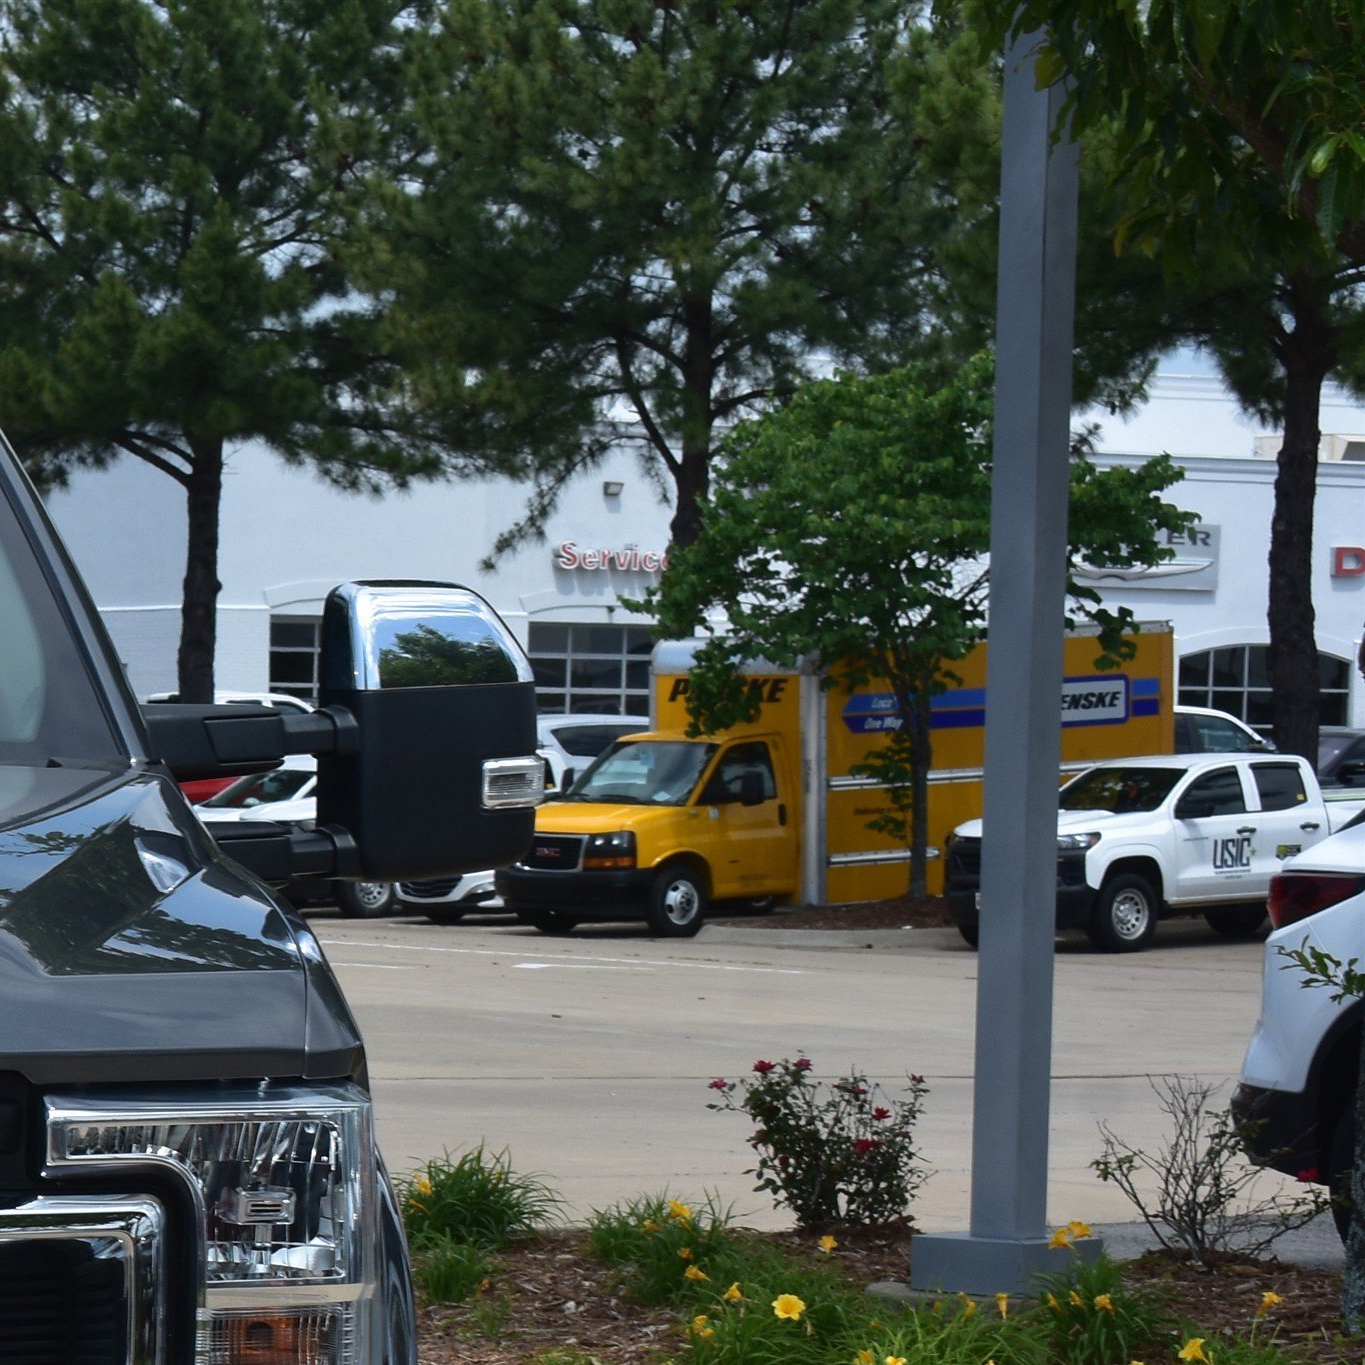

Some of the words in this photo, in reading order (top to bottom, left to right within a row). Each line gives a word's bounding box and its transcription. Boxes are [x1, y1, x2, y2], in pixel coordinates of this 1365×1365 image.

[668, 678, 787, 702] PKE
[1061, 690, 1122, 711] ENSKE
[1213, 838, 1251, 869] USIC
